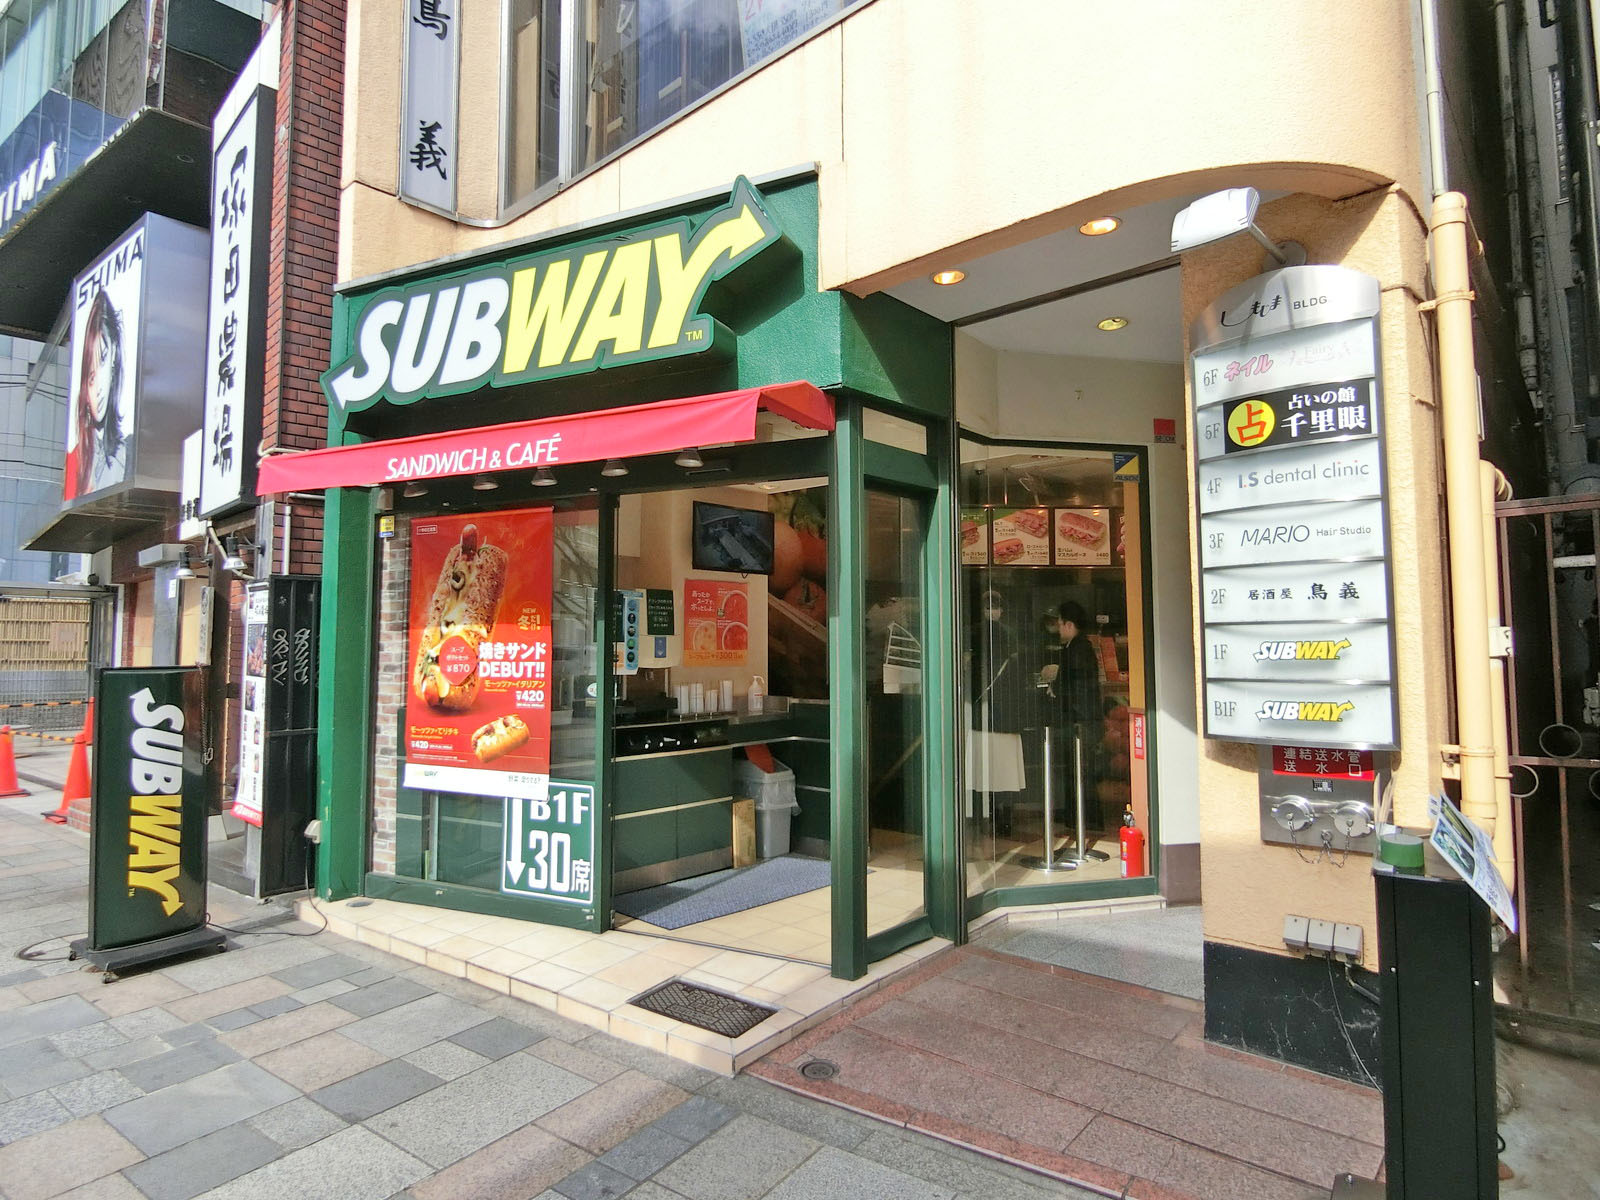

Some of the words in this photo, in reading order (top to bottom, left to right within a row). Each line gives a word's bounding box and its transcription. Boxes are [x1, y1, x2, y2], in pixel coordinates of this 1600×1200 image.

[77, 233, 143, 309] SHIMA
[331, 203, 766, 409] SUBWAY
[685, 331, 703, 341] TM
[1293, 295, 1328, 310] BLDG
[1203, 369, 1218, 386] 6F
[1224, 354, 1274, 381] ネイル
[1288, 387, 1356, 410] 占いの館
[1205, 423, 1220, 440] 5F
[1236, 403, 1266, 444] 占
[1281, 405, 1367, 437] 千里眼
[386, 446, 487, 480] SANDWICH
[489, 452, 501, 468] &
[506, 432, 562, 467] CAFÉ
[1207, 477, 1222, 495] 4F
[1238, 472, 1259, 488] I.S
[1264, 464, 1316, 485] dental
[1322, 459, 1369, 478] clinic
[1209, 533, 1224, 549] 3F
[1240, 525, 1310, 547] MARIO
[1316, 528, 1338, 537] Hair
[1340, 526, 1372, 536] Studio
[1211, 588, 1227, 604] 2F
[1248, 588, 1293, 600] 居酒屋
[1308, 581, 1360, 600] 鳥義
[478, 641, 547, 660] 焼きサンド
[1213, 644, 1228, 660] 1F
[1253, 638, 1352, 662] SUBWAY
[447, 664, 470, 672] ¥870
[478, 661, 546, 678] DEBUT!!
[1214, 700, 1237, 717] B1F
[1255, 700, 1355, 721] SUBWAY
[1284, 748, 1361, 763] 連結送水管
[1284, 760, 1362, 777] 送水口
[128, 687, 185, 917] SUBWAY
[530, 790, 590, 824] B1F
[528, 829, 591, 894] 30席
